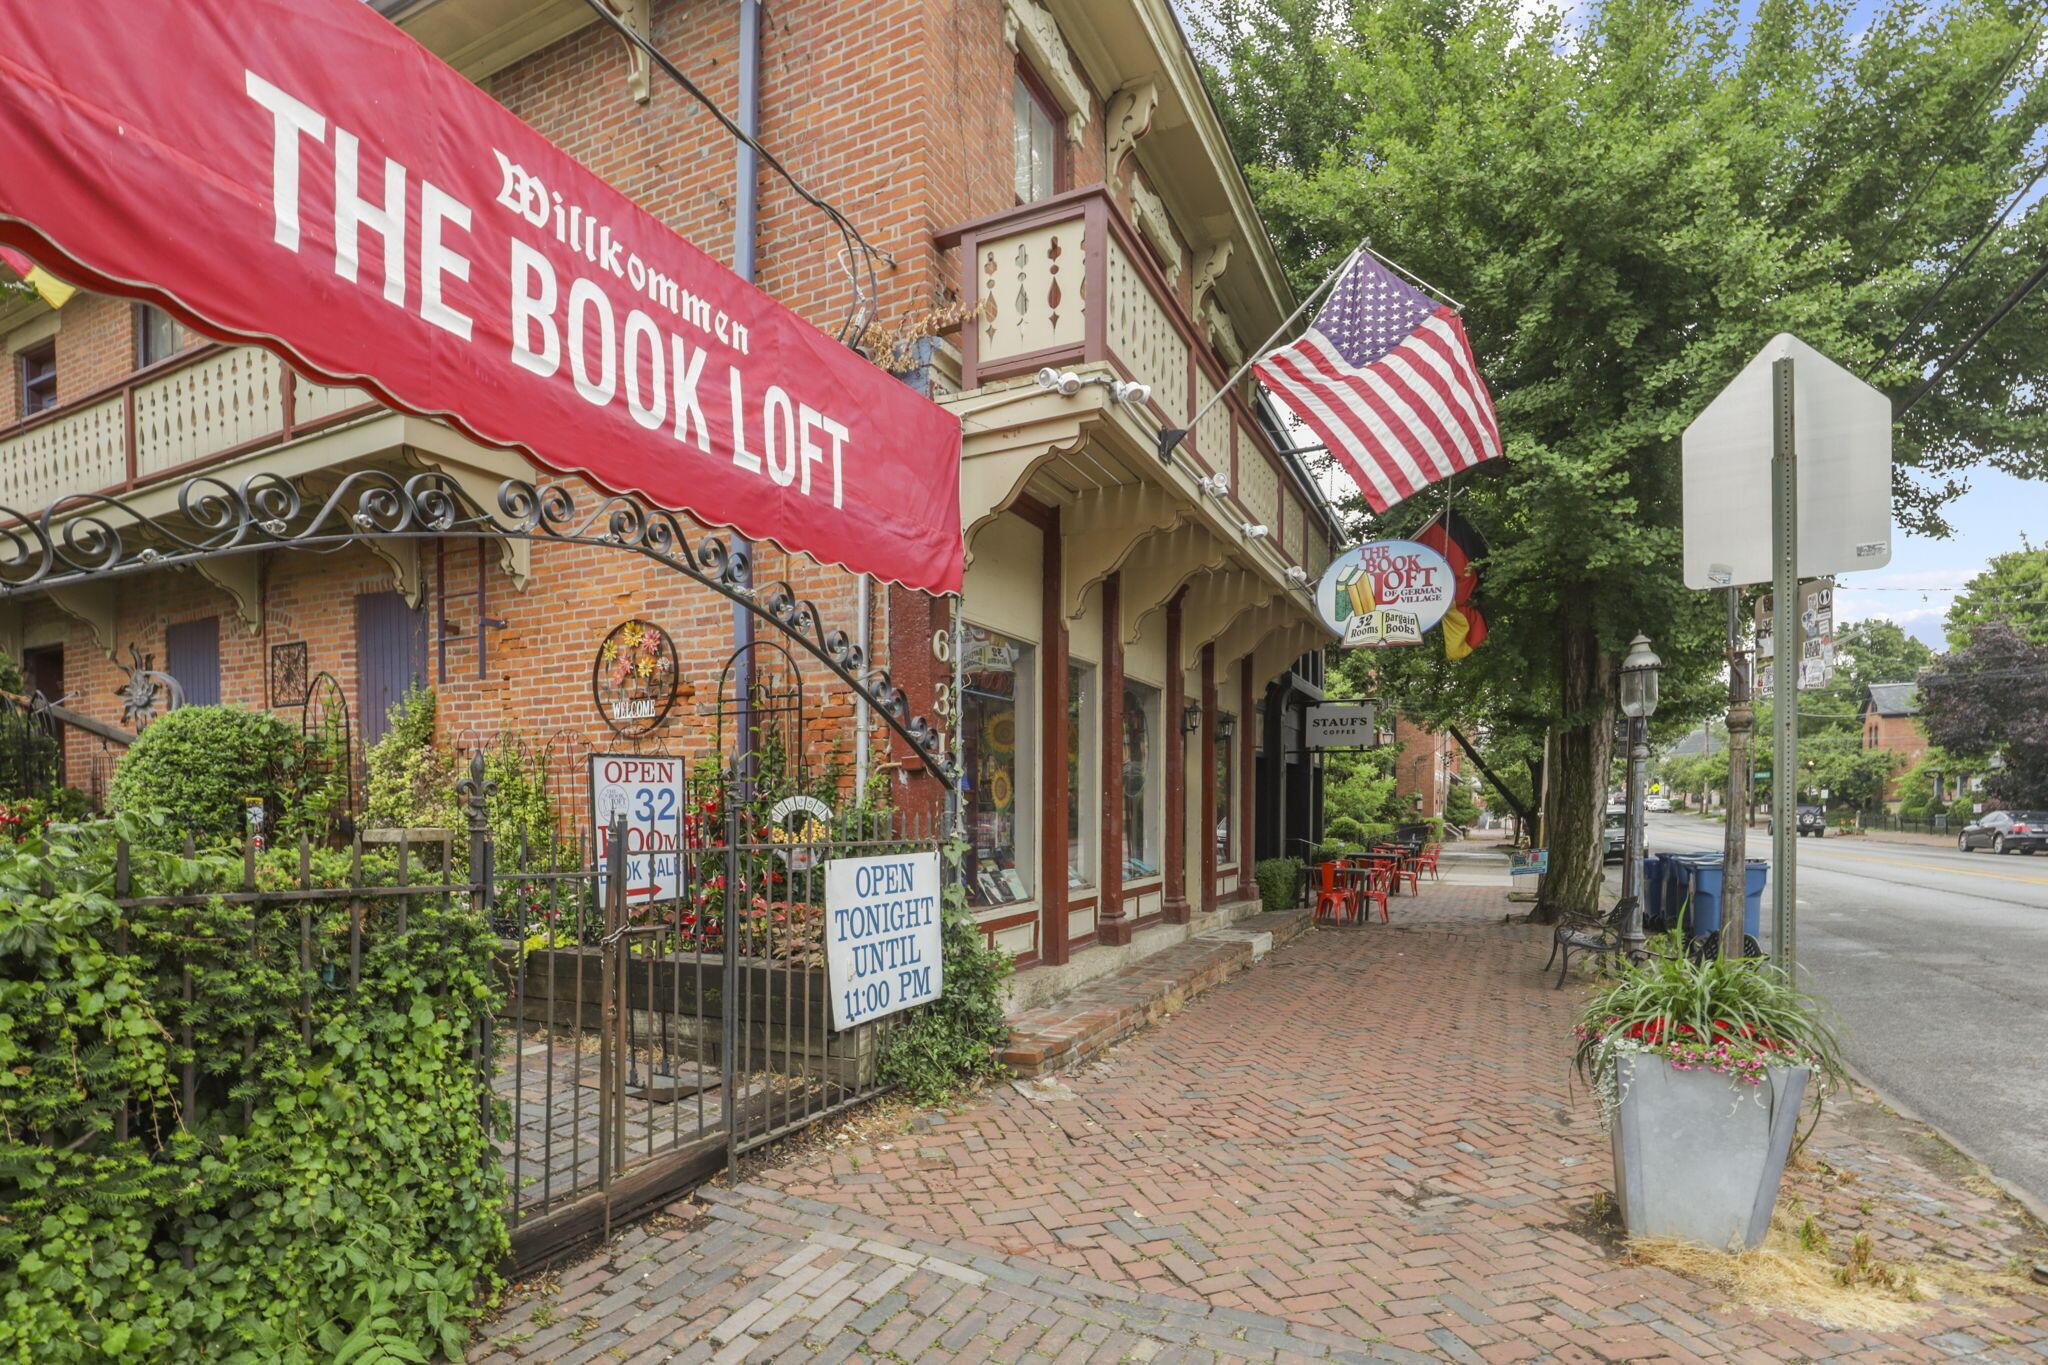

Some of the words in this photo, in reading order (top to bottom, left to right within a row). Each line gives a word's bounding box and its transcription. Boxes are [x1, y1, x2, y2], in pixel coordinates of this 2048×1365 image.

[492, 148, 749, 356] Willkommen
[245, 68, 473, 342] THE
[511, 236, 711, 455] BOOK
[729, 365, 850, 509] LOFT
[1358, 546, 1390, 560] THE
[1366, 554, 1421, 574] BOOK
[1370, 567, 1437, 605] LOFT
[1384, 590, 1398, 598] OF
[1400, 586, 1442, 596] GERMAN
[1400, 594, 1442, 604] VILLAGE
[1356, 614, 1373, 629] 32
[1385, 612, 1415, 625] Bargain
[1386, 624, 1414, 635] Books
[1351, 625, 1379, 638] Rooms
[612, 699, 656, 720] WELCOME
[604, 760, 675, 784] OPEN
[635, 787, 676, 822] 32
[855, 863, 915, 898] OPEN
[834, 896, 934, 942] TONIGHT
[852, 934, 921, 978] UNTIL
[844, 980, 890, 1020] 11:00
[898, 966, 932, 1003] PM
